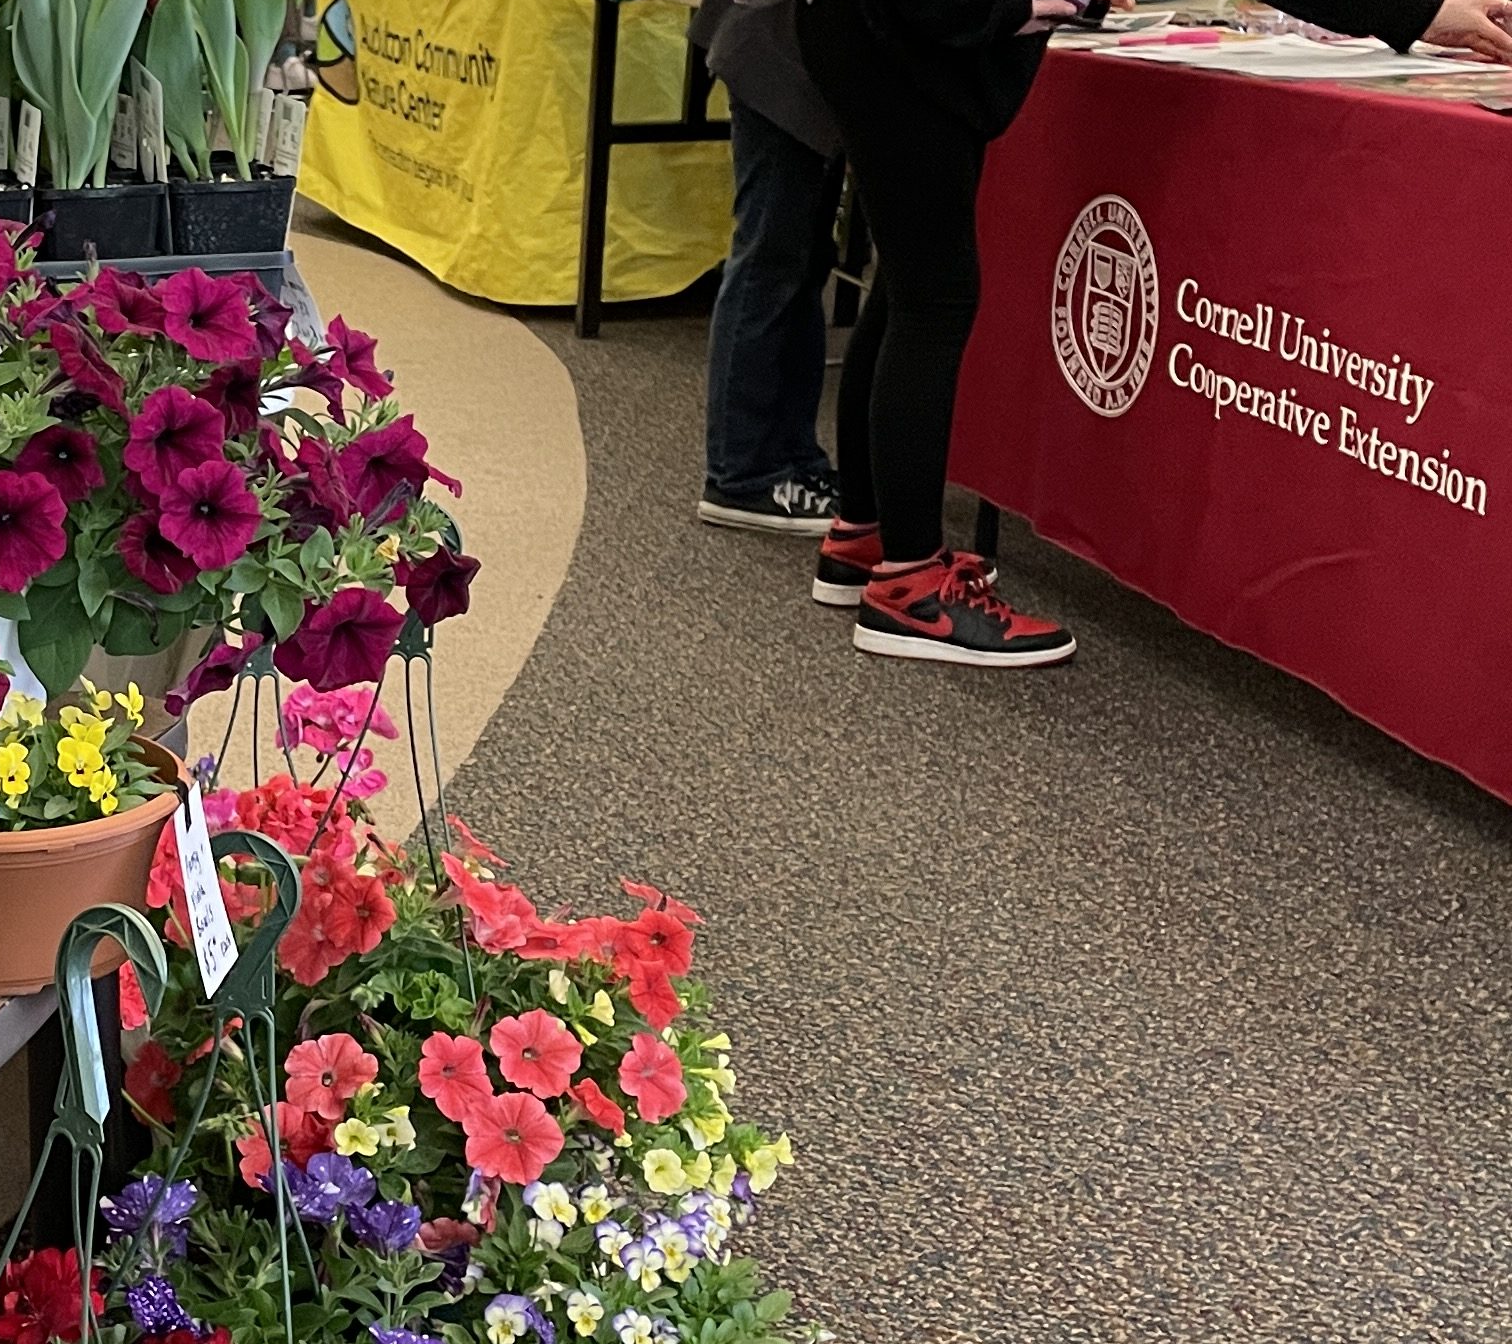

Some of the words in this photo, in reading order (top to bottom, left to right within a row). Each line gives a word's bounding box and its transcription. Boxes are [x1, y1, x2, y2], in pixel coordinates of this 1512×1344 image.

[398, 79, 446, 133] Center
[415, 28, 502, 103] Community
[1176, 277, 1274, 352] Cornell
[1278, 310, 1436, 425] University
[1167, 342, 1332, 446] Cooperative
[1337, 405, 1488, 517] Extension
